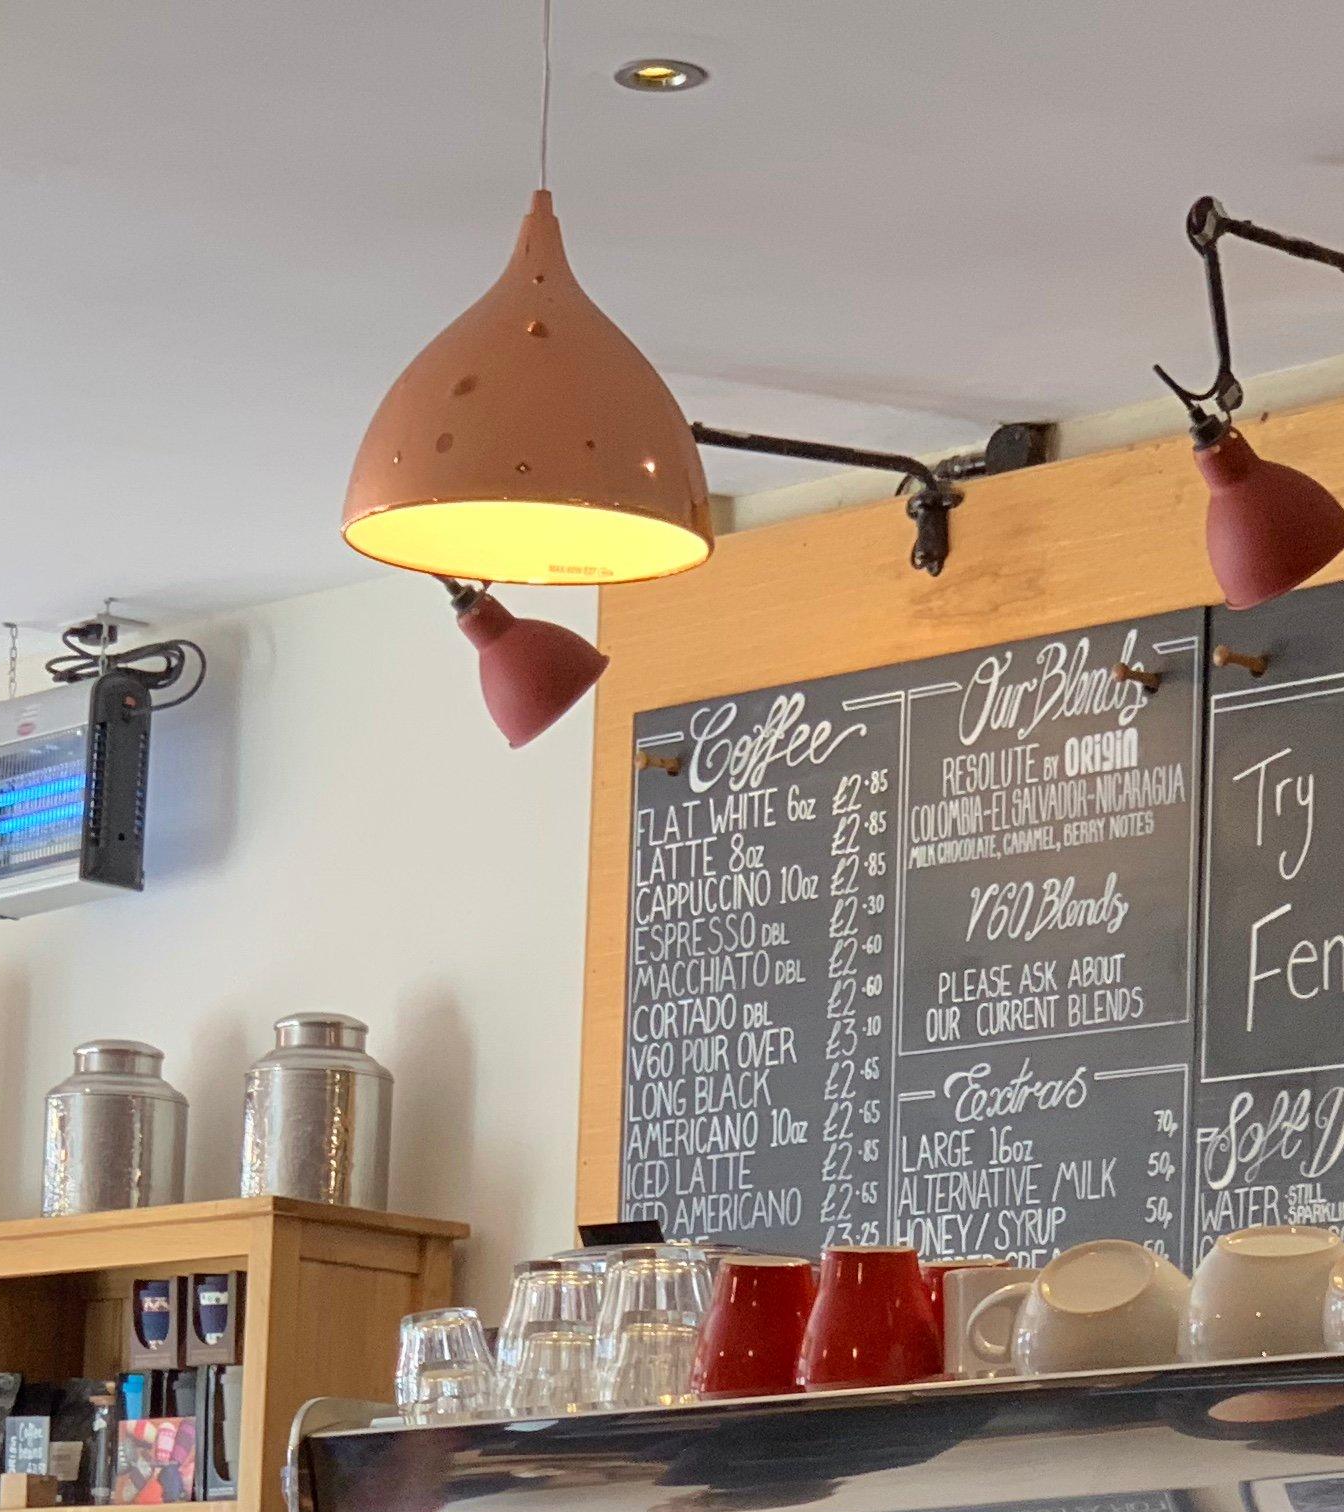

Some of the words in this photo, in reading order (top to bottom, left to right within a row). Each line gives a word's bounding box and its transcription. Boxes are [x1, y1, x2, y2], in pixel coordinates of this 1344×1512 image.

[959, 652, 1037, 745] Our
[689, 693, 867, 793] Coffee
[943, 744, 1039, 797] RESOLUTE
[1043, 756, 1058, 780] BY
[637, 801, 701, 847] FLAT
[709, 788, 777, 833] WHITE
[787, 785, 816, 820] 6oz
[1063, 819, 1105, 846] BERRY
[1109, 811, 1154, 838] NOTES
[1233, 748, 1314, 880] Try
[637, 837, 717, 887] LATTE
[729, 833, 764, 872] 8oz
[636, 870, 771, 924] CAPPUCCINO
[779, 865, 818, 904] 10oz
[1025, 872, 1129, 941] Blends
[635, 912, 757, 965] ESPRESSO
[761, 923, 791, 947] DBL
[633, 950, 770, 1003] MACCHIATO
[775, 959, 806, 984] DBL
[938, 965, 1013, 1004] PLEASE
[1019, 961, 1057, 994] ASK
[1068, 954, 1125, 988] ABOUT
[634, 993, 736, 1042] CORTADO
[926, 1008, 960, 1042] OUR
[976, 996, 1060, 1036] CURRENT
[1068, 987, 1143, 1027] BLENDS
[631, 1043, 673, 1080] V60
[682, 1035, 729, 1075] POUR
[738, 1027, 796, 1068] OVER
[629, 1079, 686, 1122] LONG
[695, 1069, 771, 1115] BLACK
[943, 1058, 1087, 1122] Extras
[627, 1111, 758, 1160] AMERICANO
[902, 1128, 975, 1172] LARGE
[989, 1126, 1034, 1165] 16oz
[1205, 1089, 1311, 1189] Soft
[627, 1160, 669, 1200] ICED
[676, 1151, 755, 1195] LATTE
[898, 1164, 1042, 1216] ALTERNATIVE
[1052, 1158, 1117, 1202] MILK
[673, 1188, 801, 1234] AMERICANO
[896, 1214, 973, 1256] HONEY
[995, 1207, 1066, 1251] SYRUP
[1201, 1185, 1281, 1231] WATER
